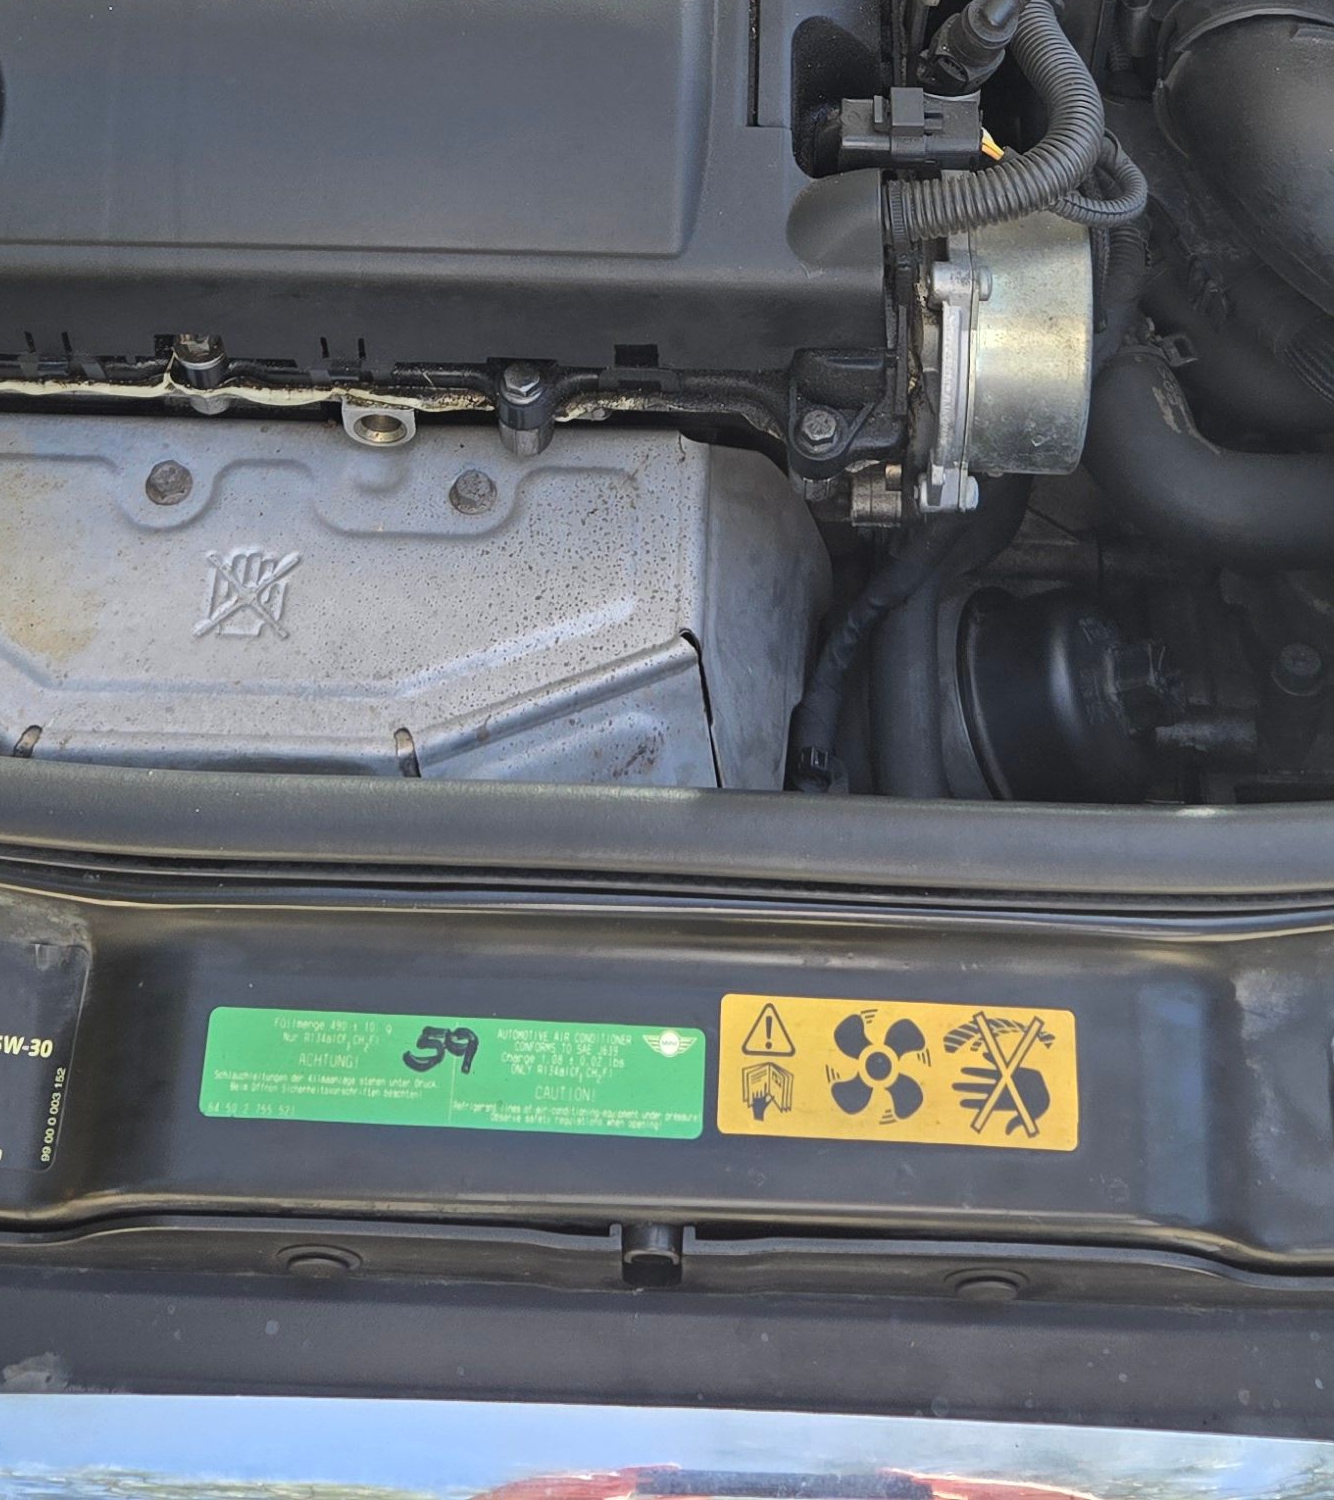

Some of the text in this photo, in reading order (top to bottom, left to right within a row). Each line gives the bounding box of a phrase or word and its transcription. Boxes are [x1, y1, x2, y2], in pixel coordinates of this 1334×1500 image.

[282, 1032, 298, 1041] Nur
[496, 1029, 632, 1044] AUTOMOTIVE AIR CONDITIONER
[403, 1026, 479, 1074] 59
[514, 1041, 556, 1052] CONFORMS
[561, 1044, 572, 1053] TO
[576, 1045, 592, 1054] SAE
[298, 1053, 359, 1068] ACHTUNG!
[500, 1053, 535, 1063] Charge
[510, 1064, 531, 1074] ONLY
[534, 1085, 596, 1102] CAUTION!
[41, 1067, 66, 1162] 99 00 0 003 152
